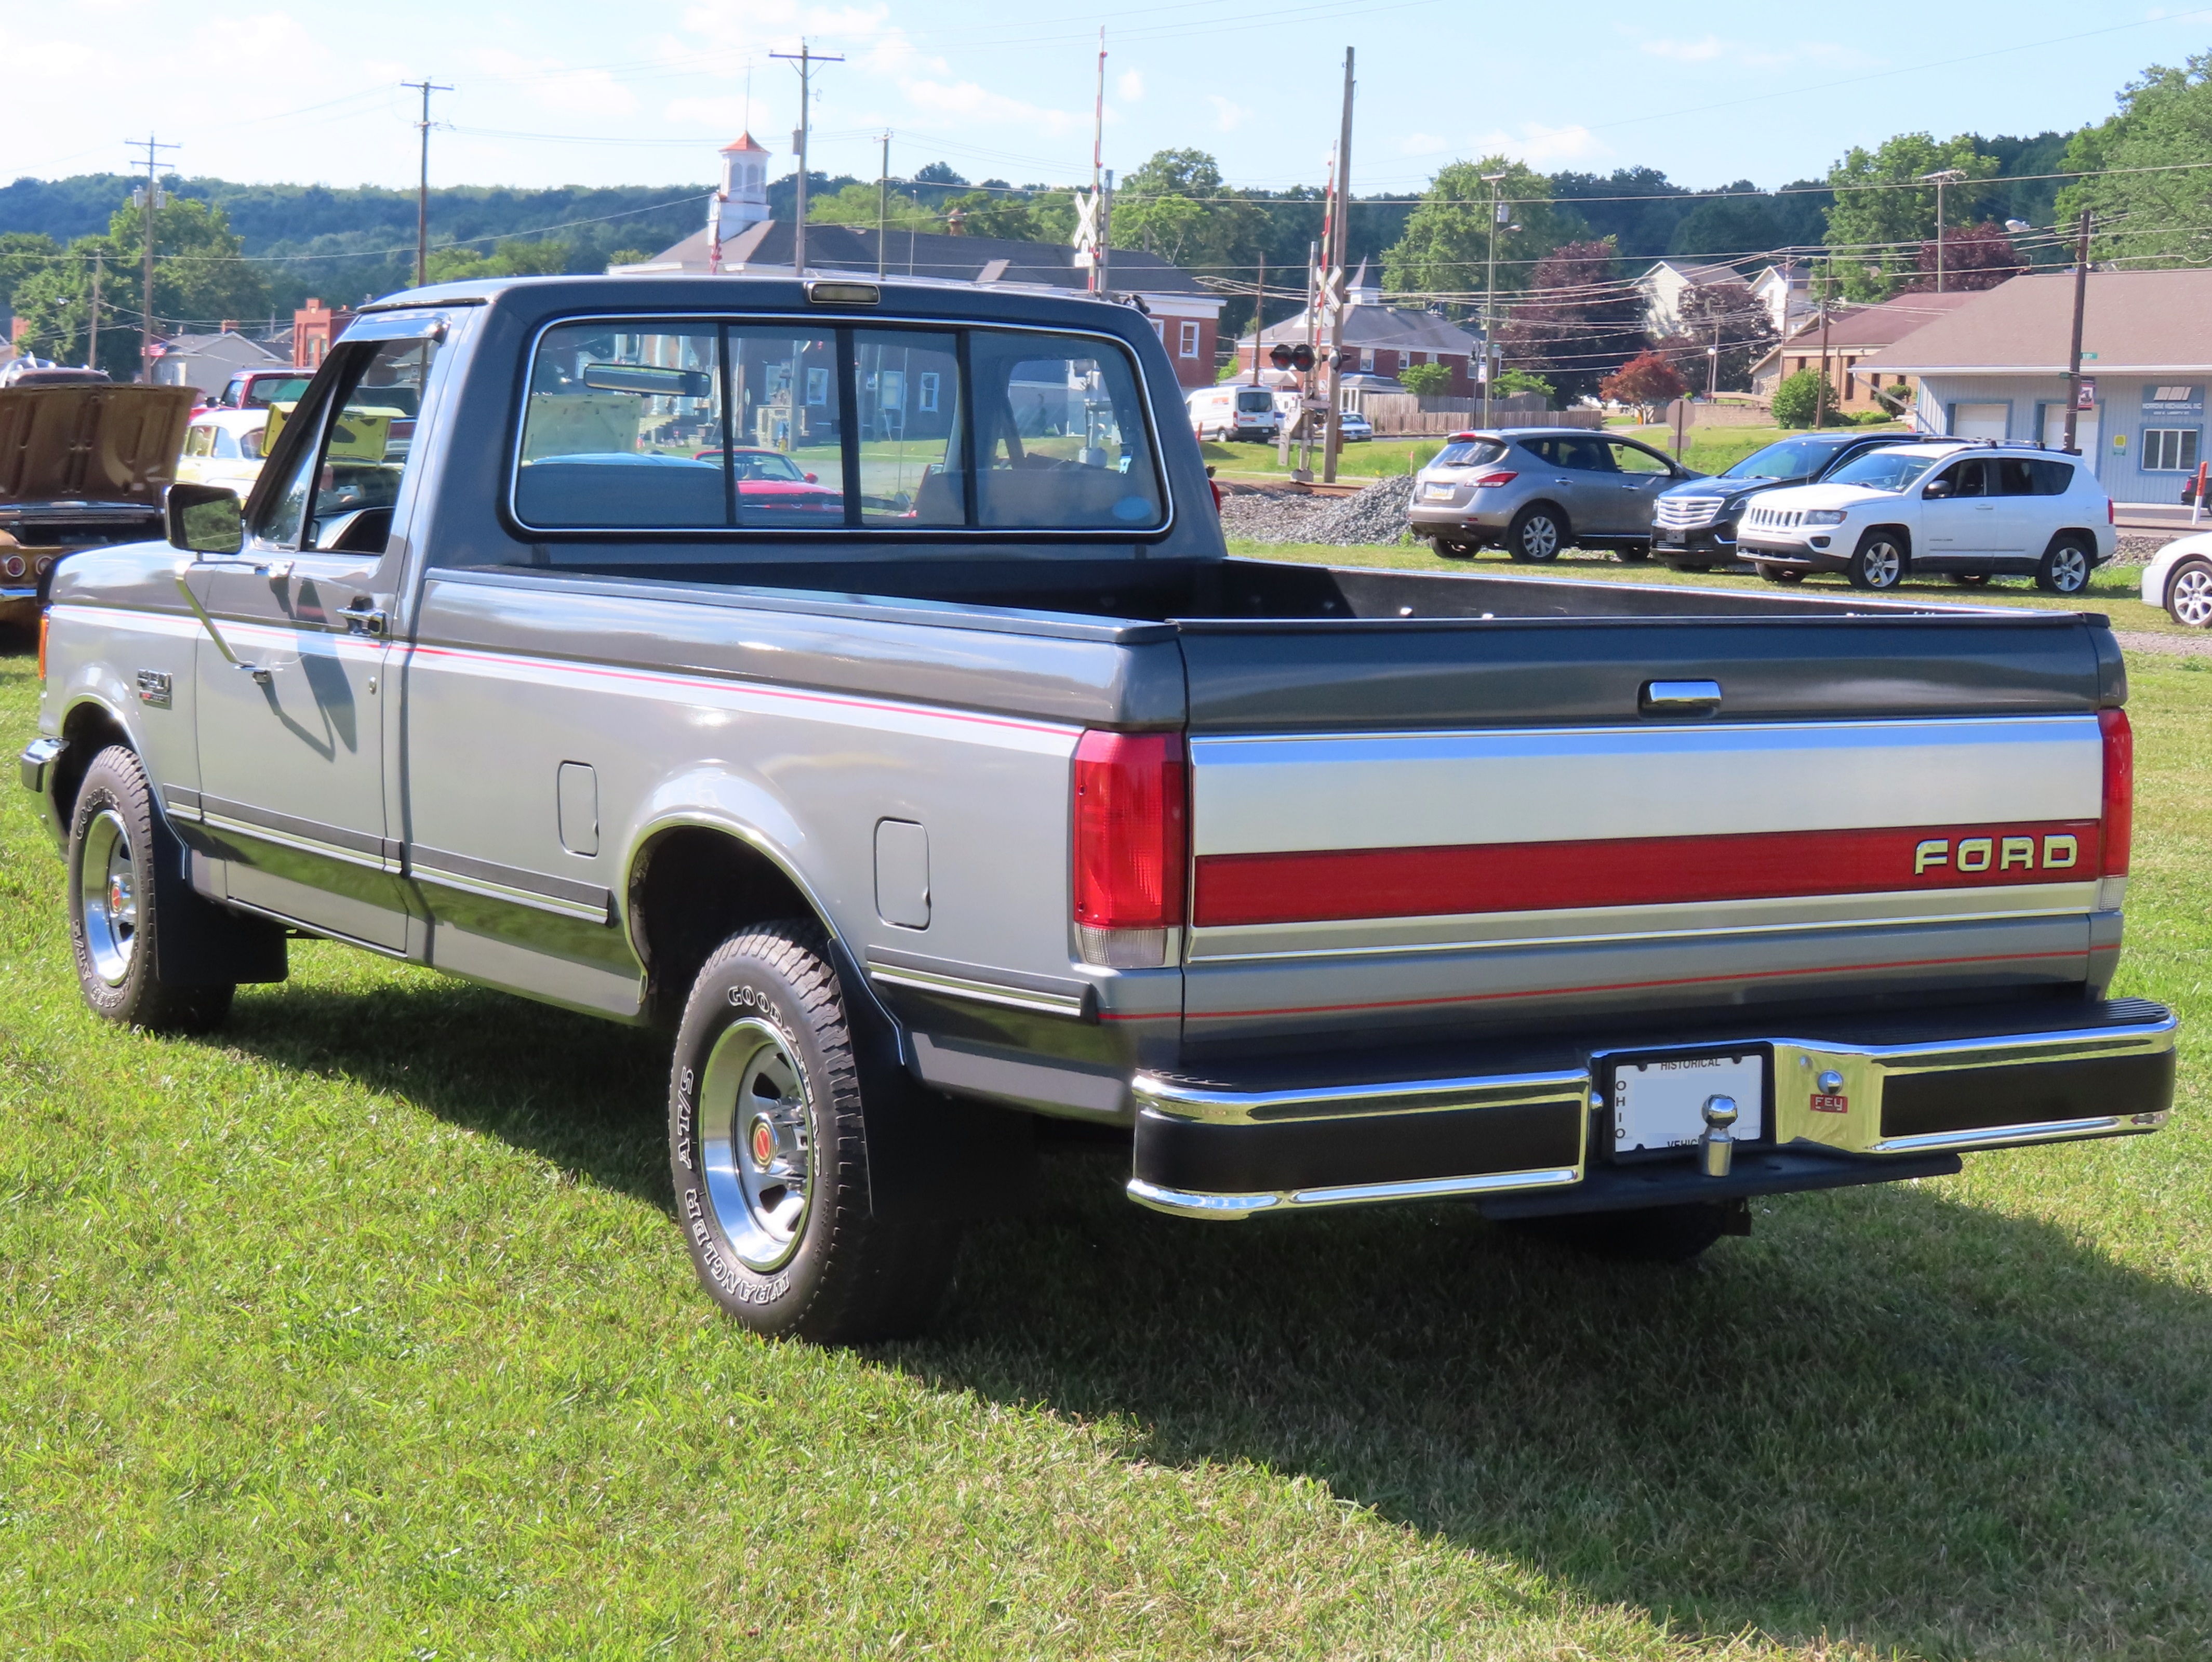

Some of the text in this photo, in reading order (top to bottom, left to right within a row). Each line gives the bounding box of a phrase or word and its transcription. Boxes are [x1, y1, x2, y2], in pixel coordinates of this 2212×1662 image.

[1914, 833, 2077, 875] FORD
[727, 985, 821, 1177] GOODYEAR
[1660, 1059, 1721, 1071] HISTORICAL
[1615, 1080, 1627, 1139] OHIO
[1815, 1096, 1843, 1111] FEY
[1667, 1138, 1700, 1147] VEHIC
[677, 1066, 791, 1305] WRANGLER AT/S
